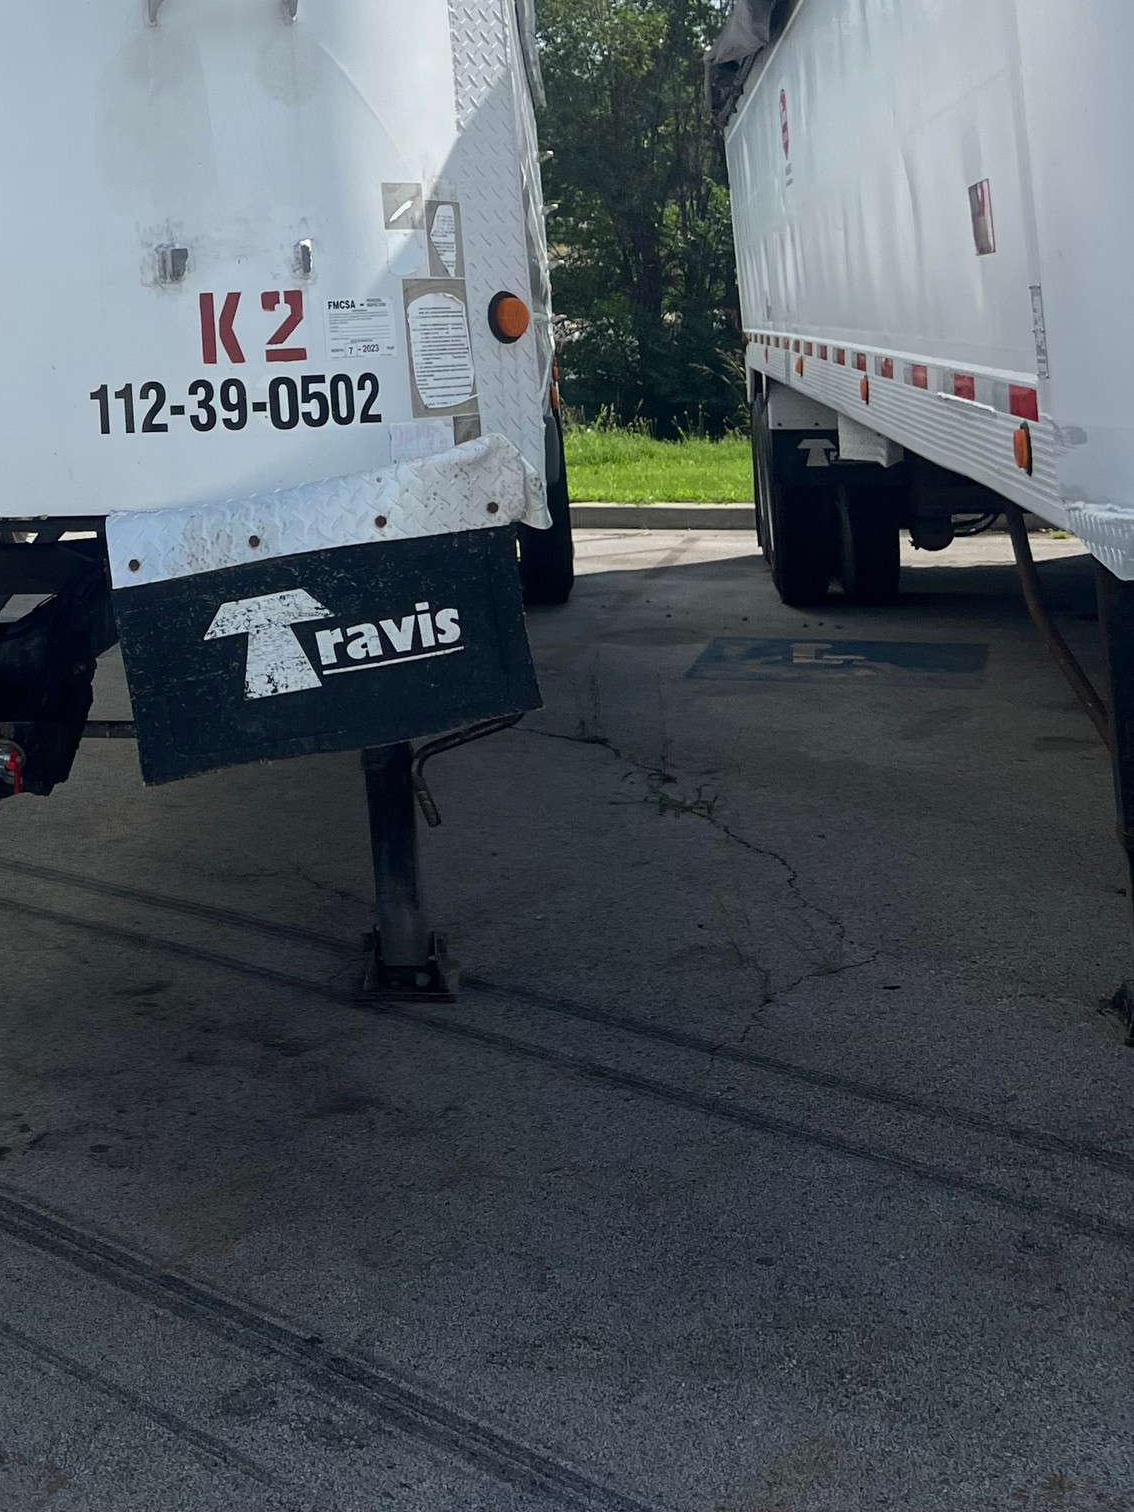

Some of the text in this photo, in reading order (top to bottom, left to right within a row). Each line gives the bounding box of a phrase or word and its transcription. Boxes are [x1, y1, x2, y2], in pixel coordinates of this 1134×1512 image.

[327, 300, 356, 310] FMCSA
[89, 372, 382, 435] 112-39-0502
[204, 588, 461, 701] Travis
